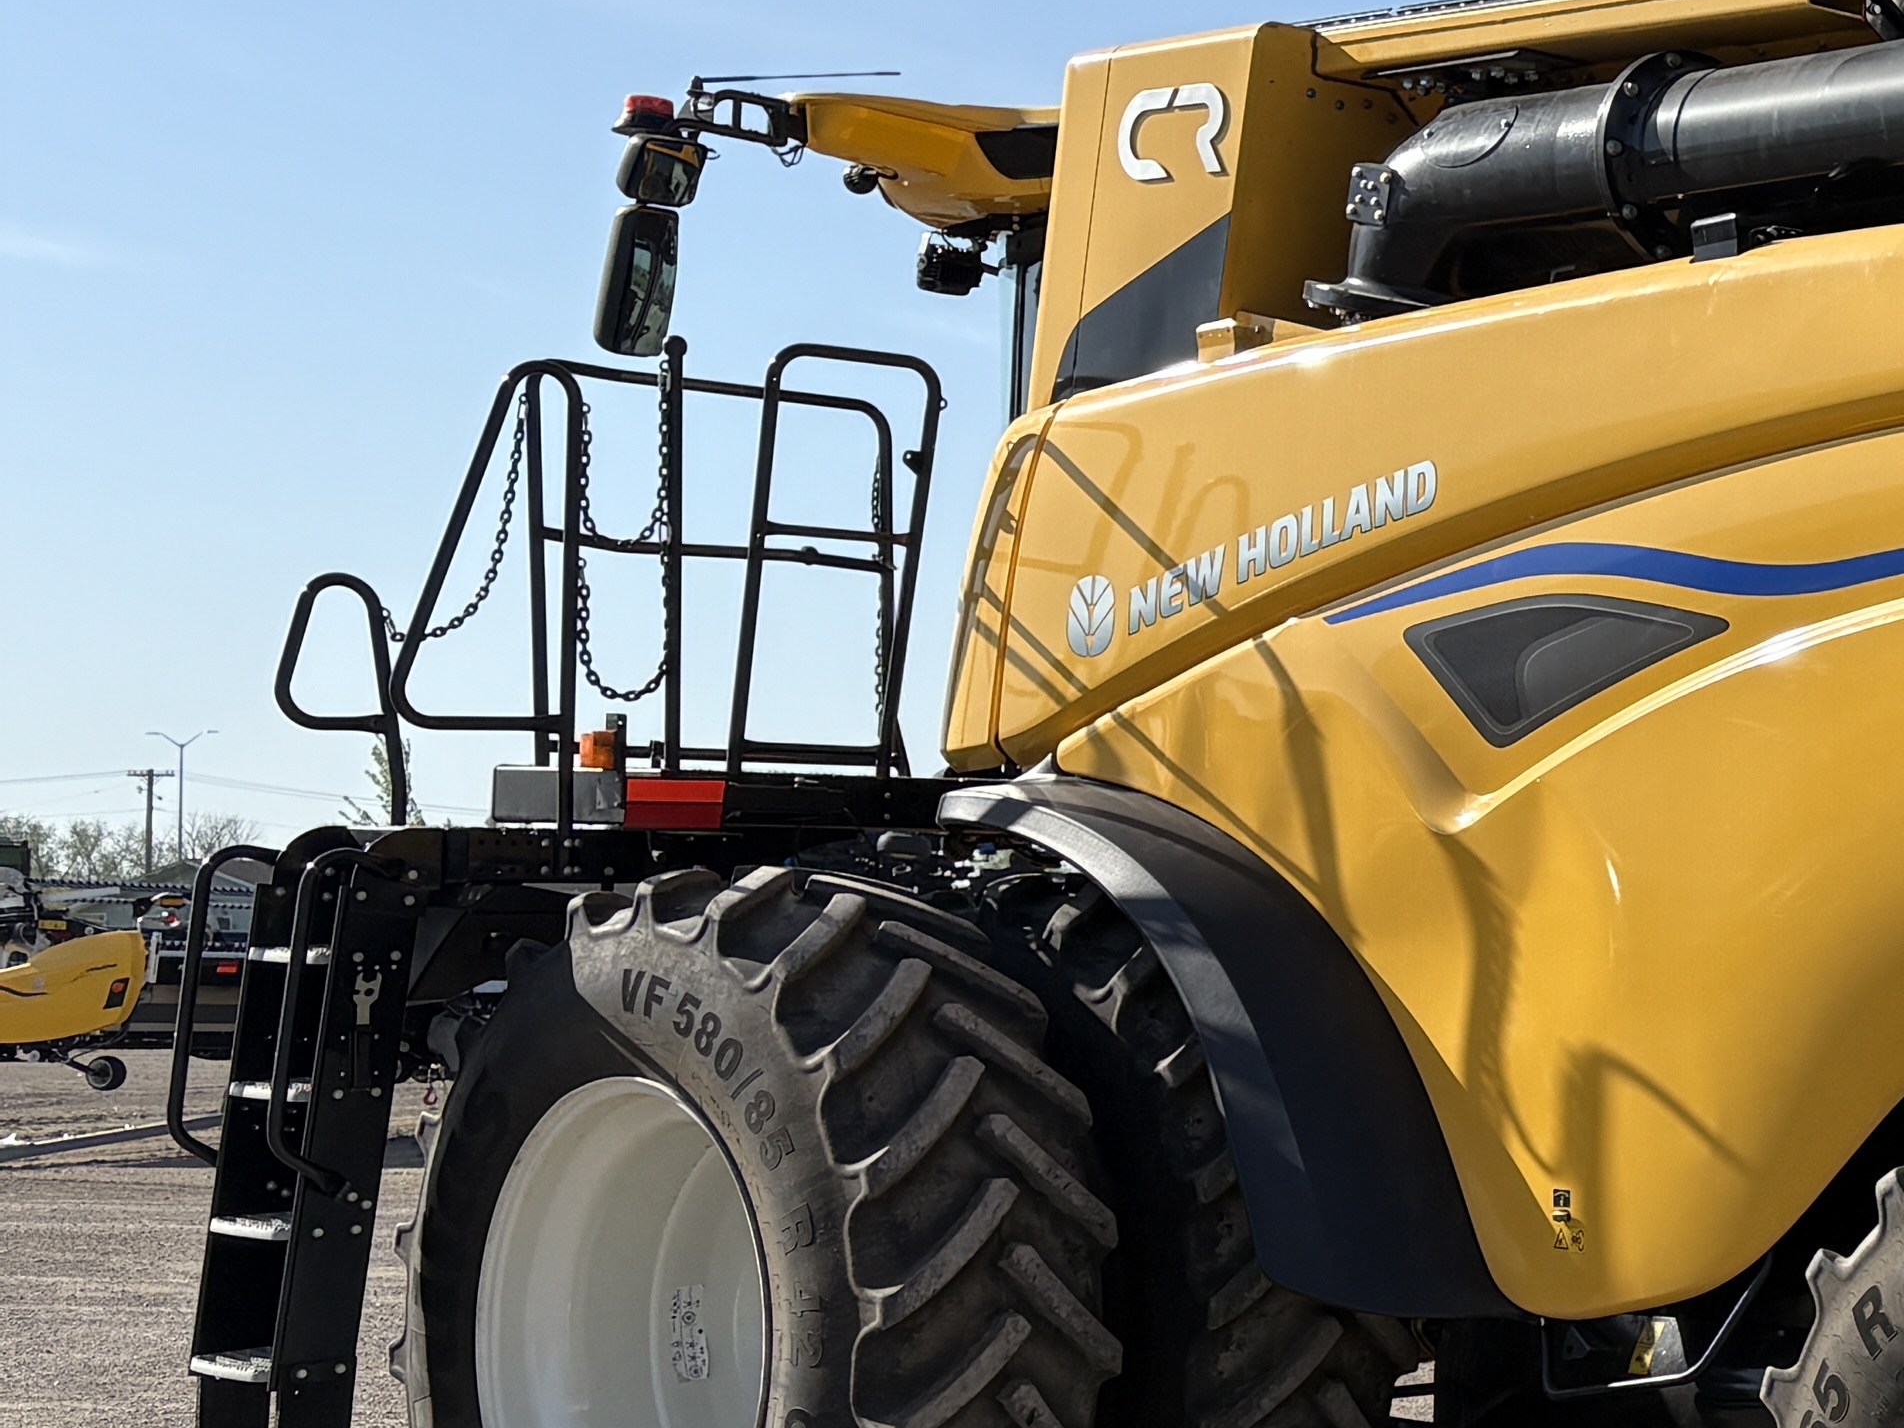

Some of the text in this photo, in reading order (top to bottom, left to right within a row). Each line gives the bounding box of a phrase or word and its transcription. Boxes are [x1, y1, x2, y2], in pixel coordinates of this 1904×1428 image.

[1117, 82, 1227, 183] CR
[1128, 459, 1438, 636] NEW HOLLAND
[621, 968, 672, 1020] VF
[672, 992, 796, 1172] 580/85
[1852, 1285, 1898, 1360] R
